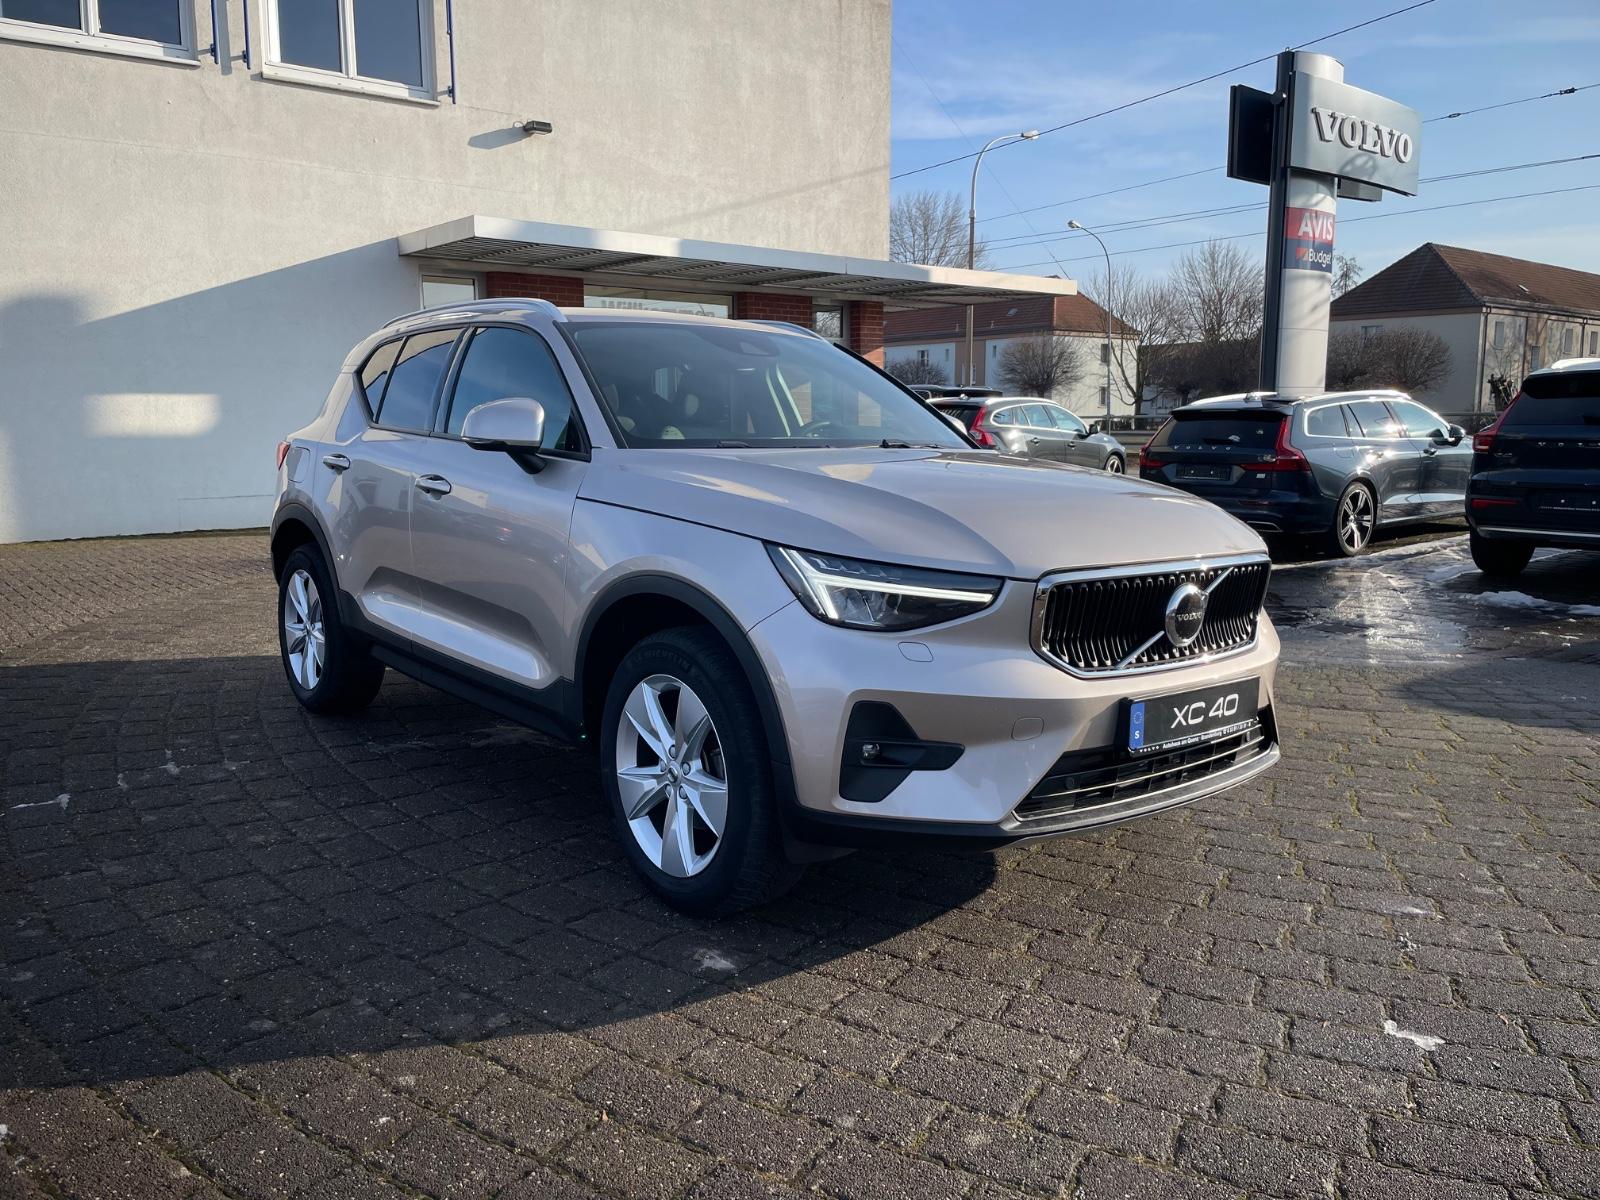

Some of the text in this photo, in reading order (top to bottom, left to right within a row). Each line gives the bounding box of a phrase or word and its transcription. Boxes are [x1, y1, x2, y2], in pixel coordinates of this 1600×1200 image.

[1311, 107, 1412, 163] VOLVO
[1298, 213, 1333, 241] AVIS
[1308, 248, 1332, 267] Budget
[1176, 611, 1202, 622] VOLVO
[1171, 701, 1206, 729] XC
[1208, 693, 1239, 718] 40
[1134, 730, 1140, 739] S
